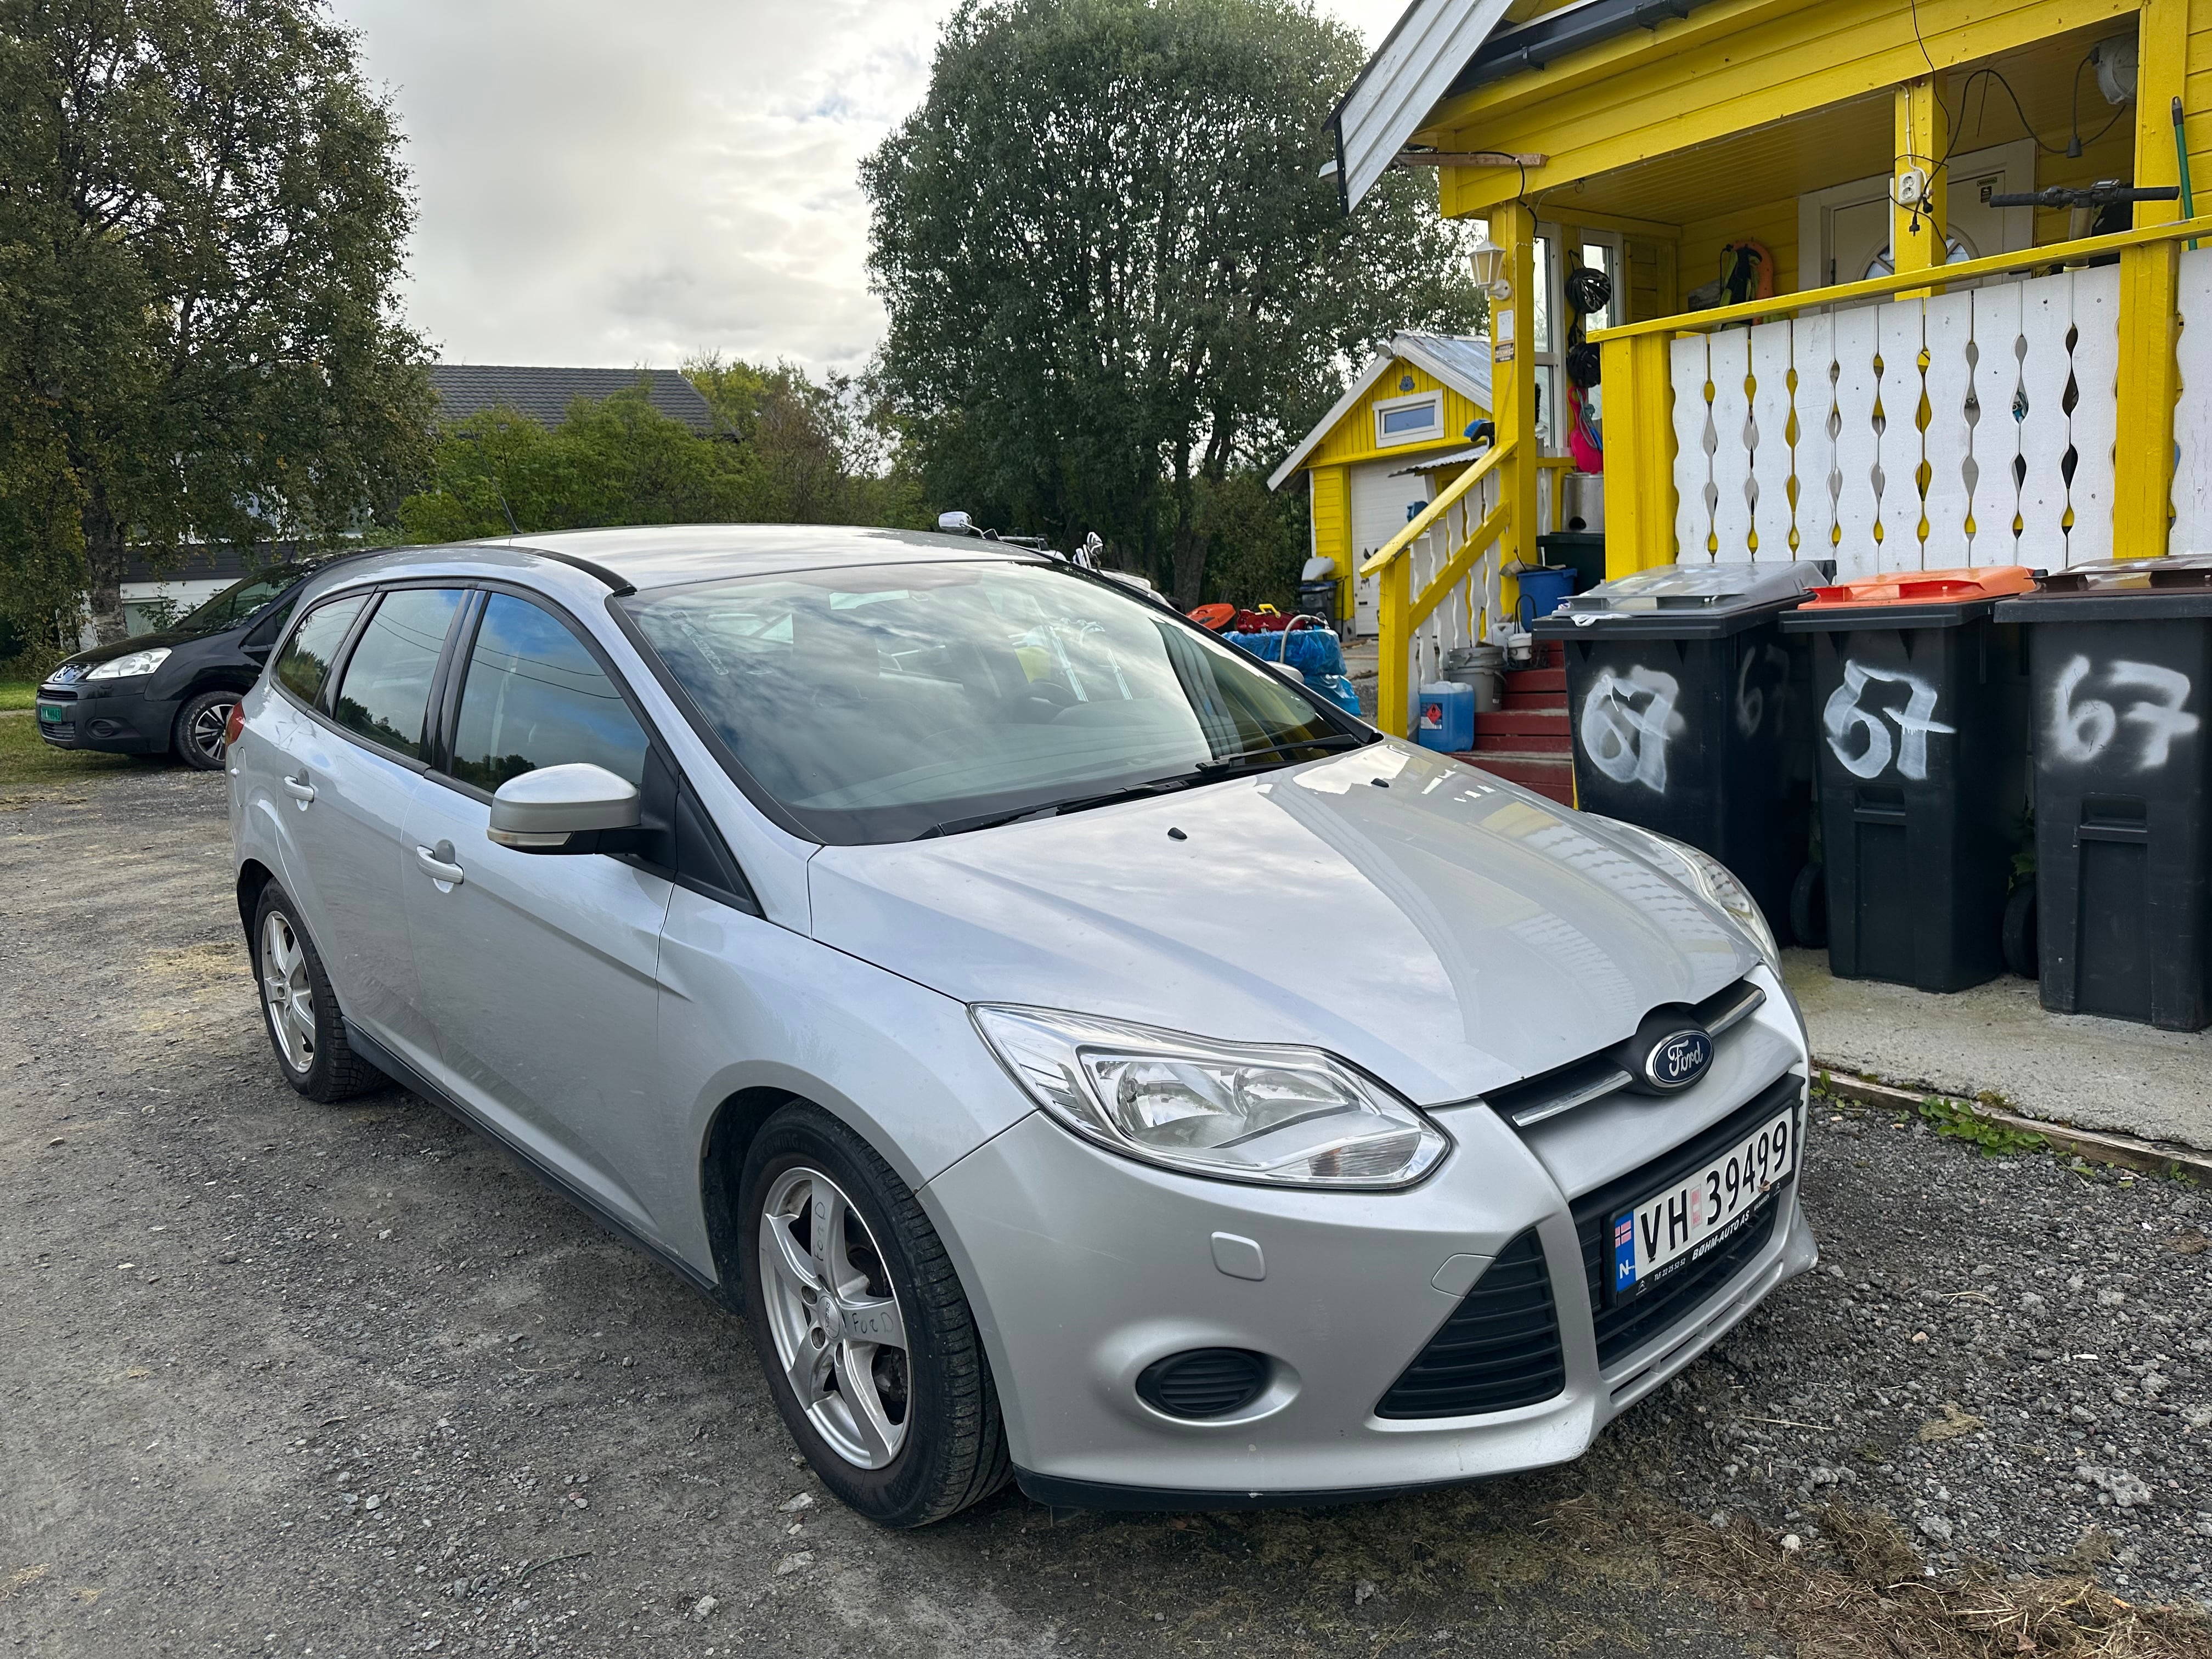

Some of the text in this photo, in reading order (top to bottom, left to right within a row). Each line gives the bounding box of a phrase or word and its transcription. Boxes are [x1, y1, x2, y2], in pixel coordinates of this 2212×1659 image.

[1823, 659, 1956, 780] 67
[2053, 655, 2199, 770] 67
[1668, 1039, 1703, 1076] Ford
[1640, 1121, 1787, 1263] VH 39499
[1619, 1259, 1629, 1279] N
[1662, 1268, 1668, 1277] 22
[1692, 1219, 1739, 1261] BØHM-AUTO
[1740, 1210, 1750, 1226] AS
